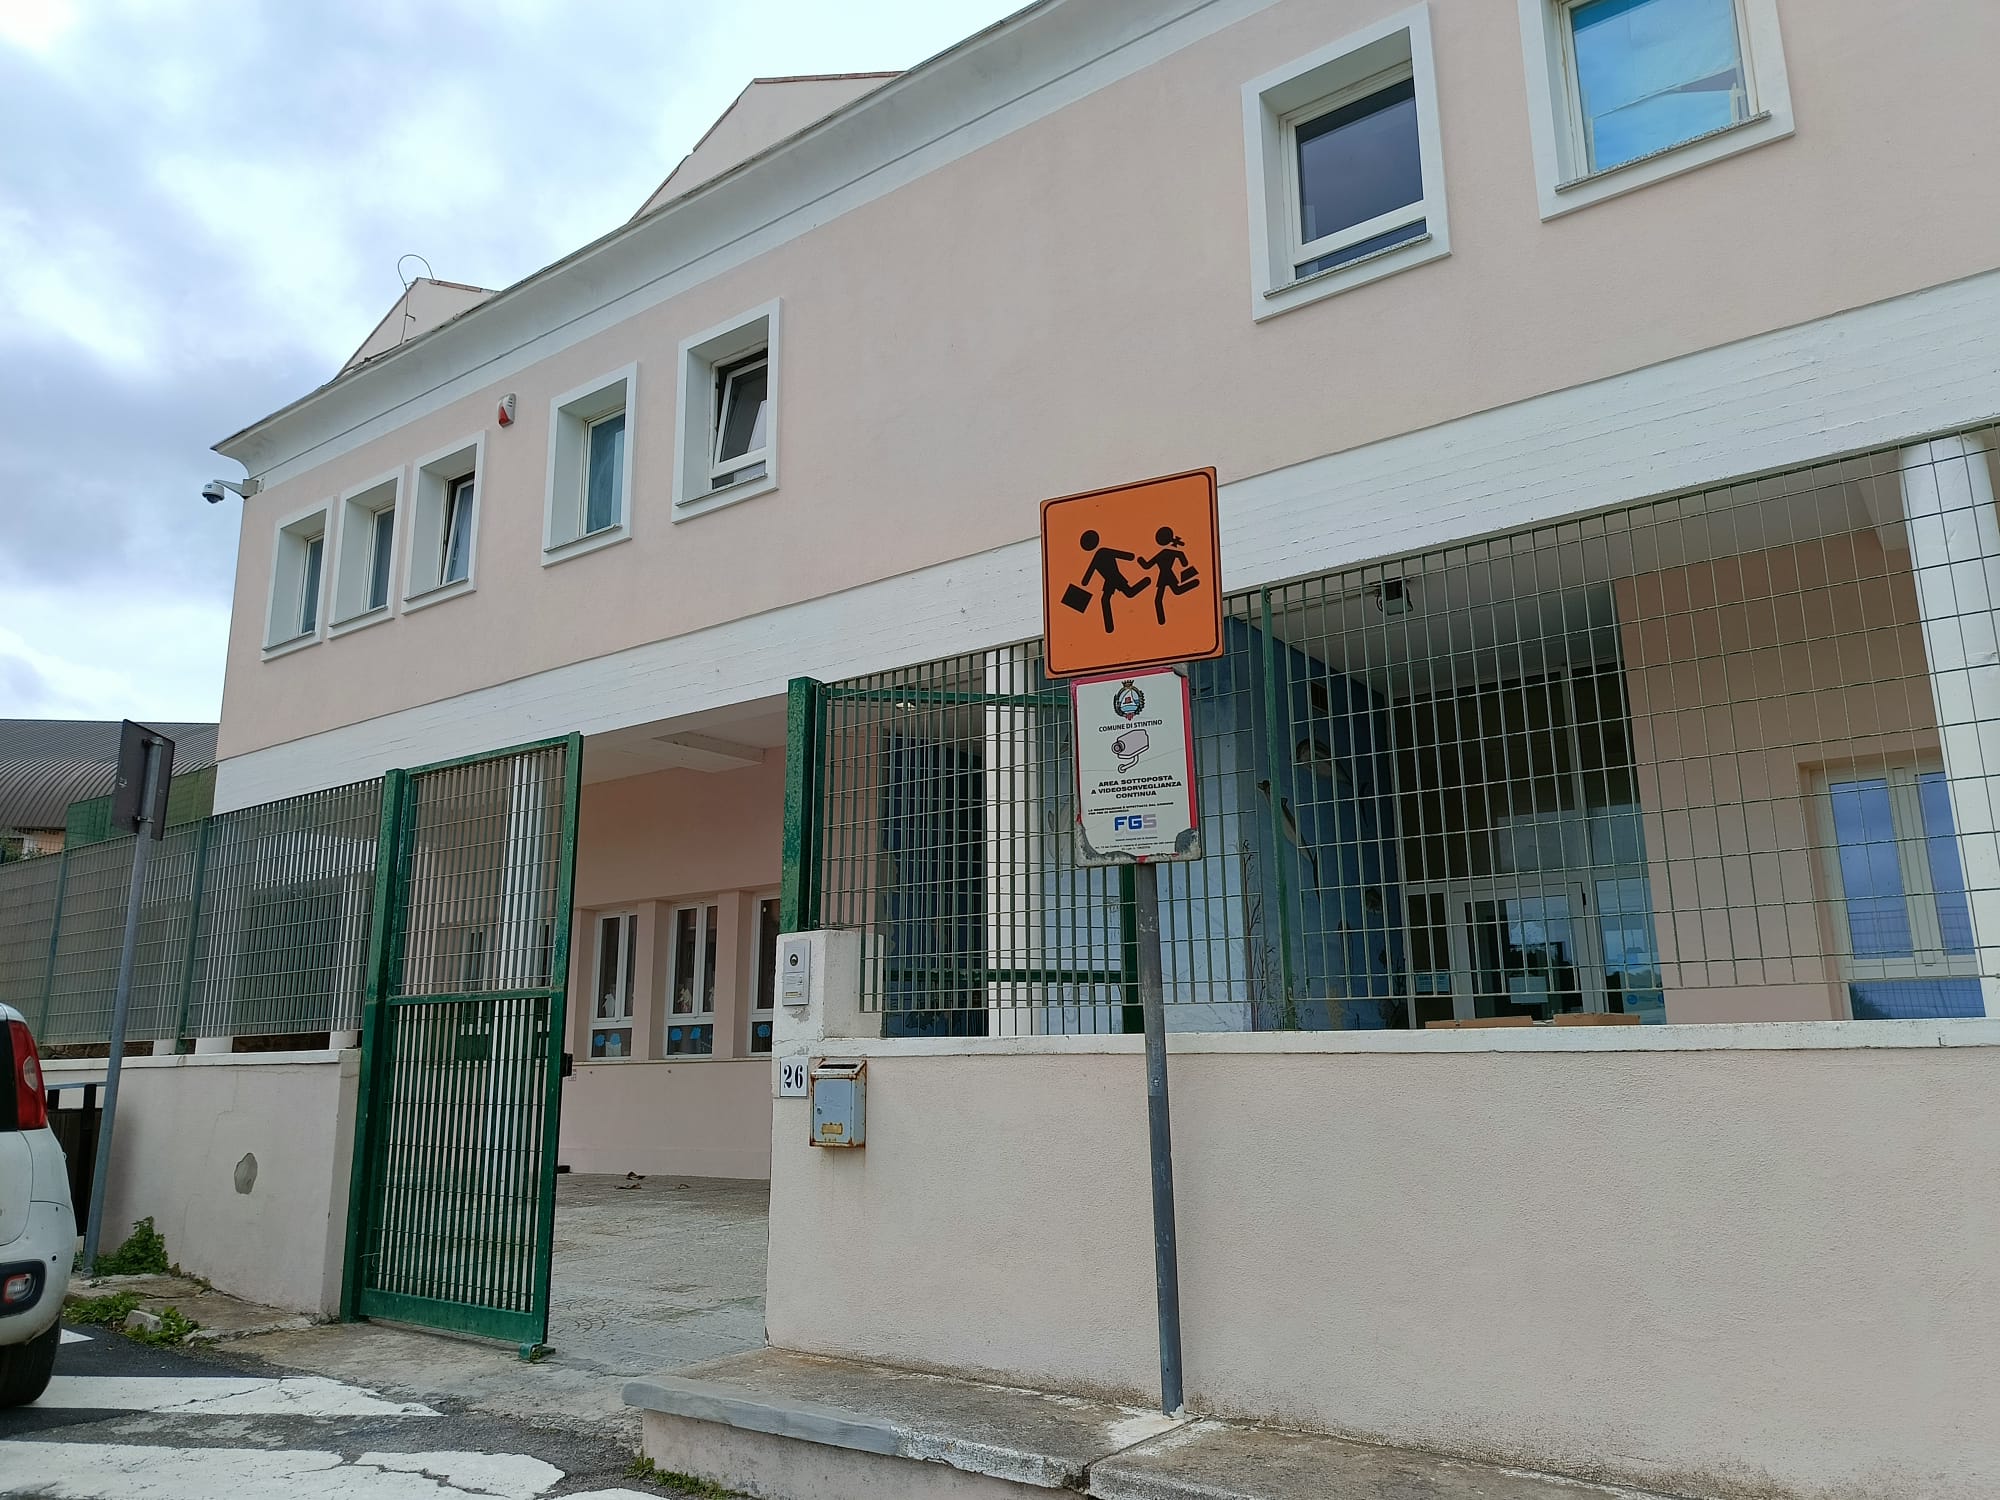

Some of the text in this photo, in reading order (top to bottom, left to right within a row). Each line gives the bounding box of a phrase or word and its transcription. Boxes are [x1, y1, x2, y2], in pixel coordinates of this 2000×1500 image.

[1098, 723, 1125, 732] COMUNE
[1133, 719, 1163, 728] STINTINO
[1121, 775, 1173, 785] SOTTOPOSTA
[1098, 781, 1182, 794] VIDEOSORVEGLIANZA
[1115, 790, 1157, 799] CONTINUA
[1114, 813, 1157, 831] FGS
[783, 1064, 804, 1089] 26
